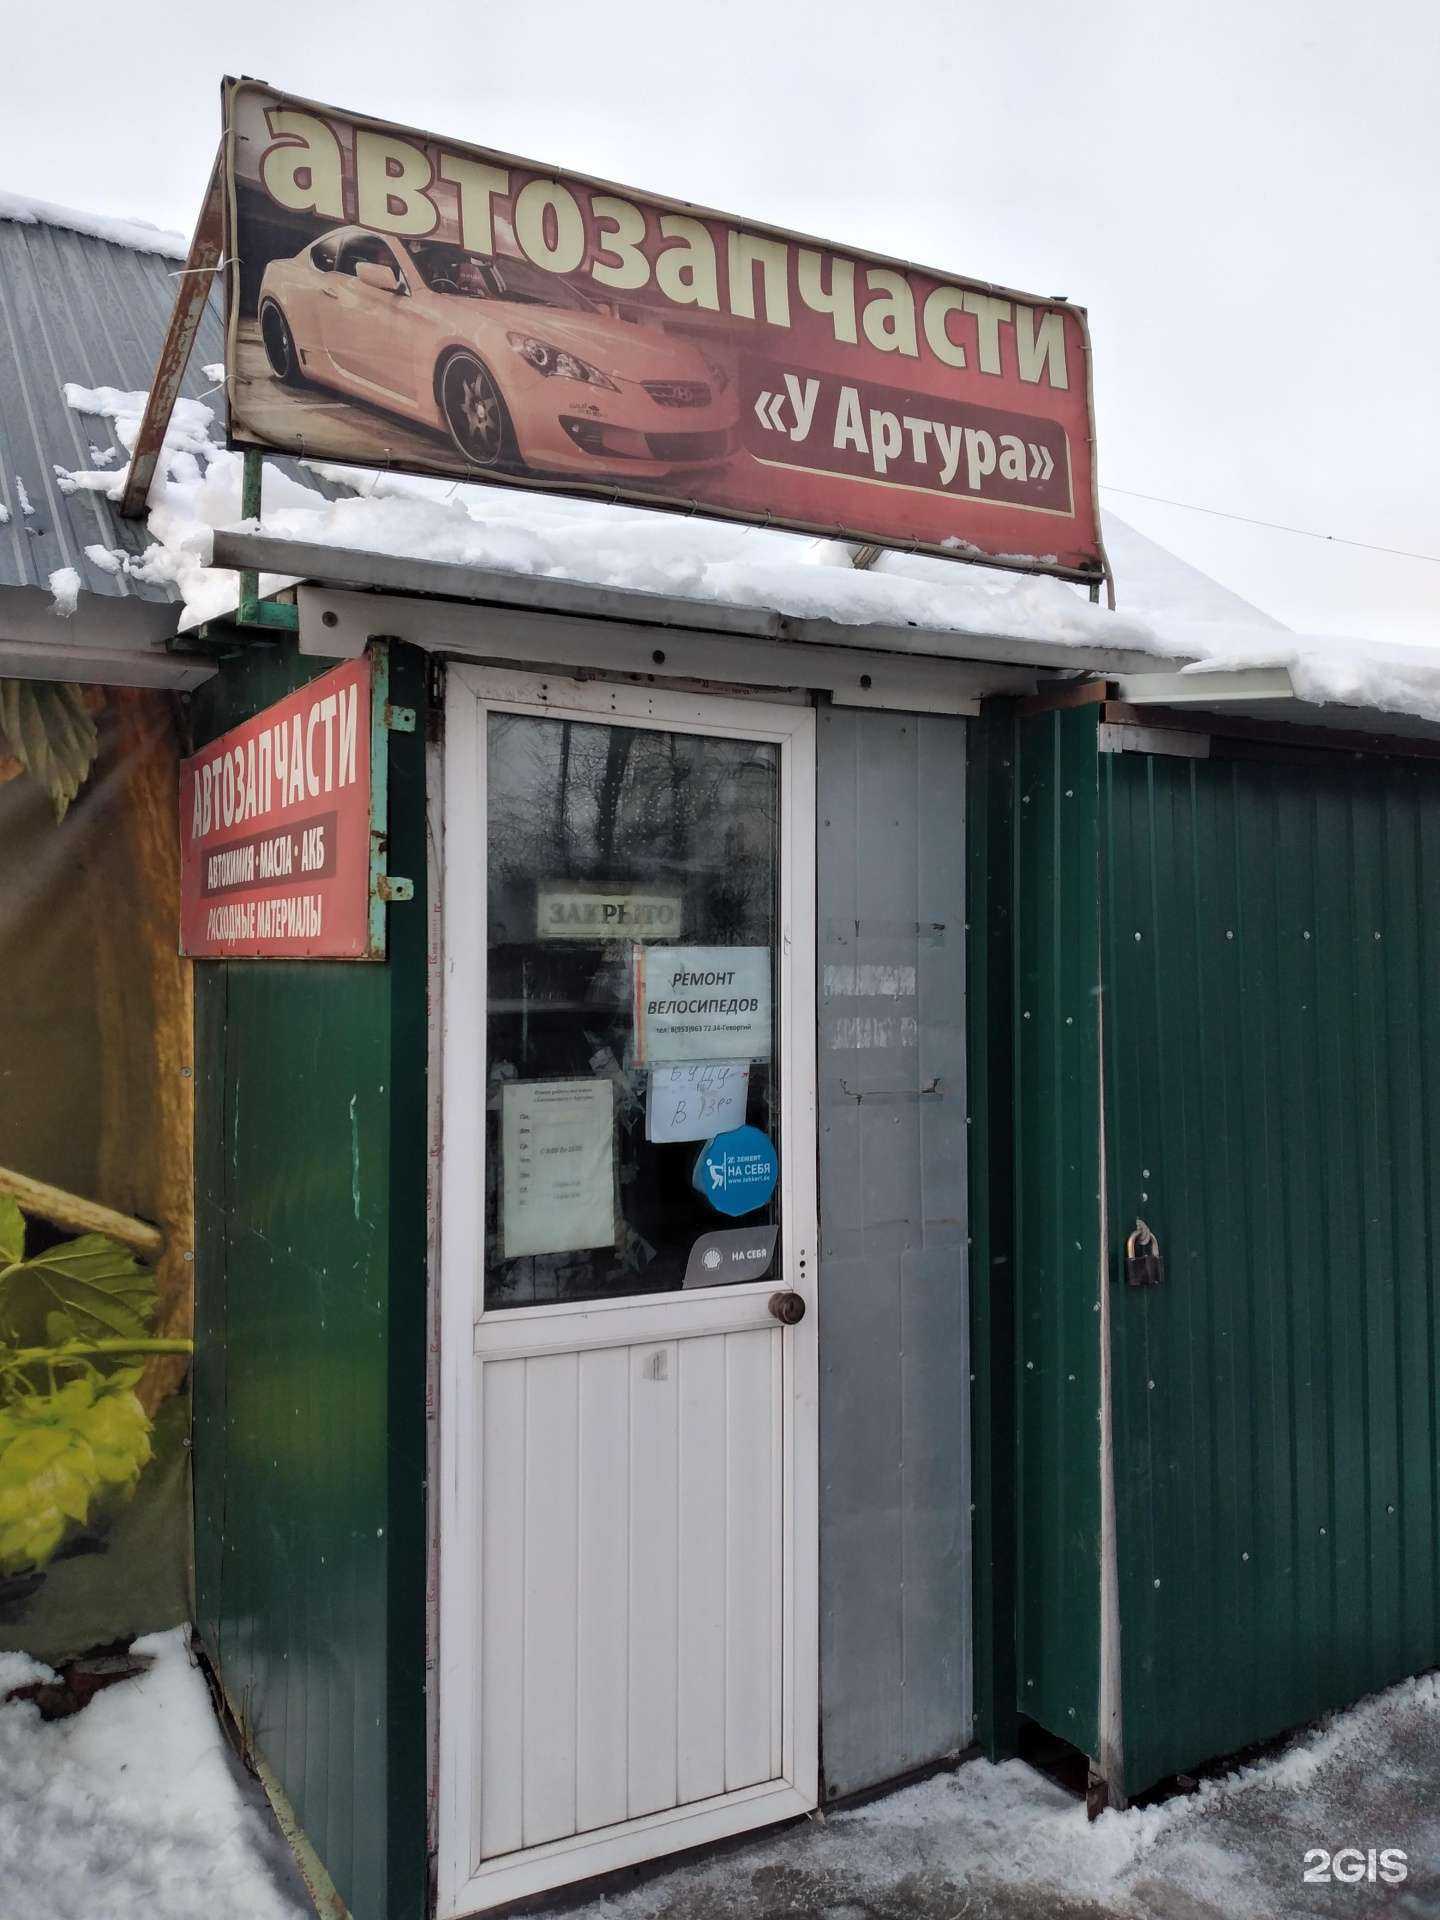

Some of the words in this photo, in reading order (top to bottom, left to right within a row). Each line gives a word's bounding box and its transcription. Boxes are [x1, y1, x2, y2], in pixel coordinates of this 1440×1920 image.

[262, 106, 1070, 391] автозапчасти
[833, 385, 1055, 490] Артура»
[192, 683, 358, 840] АВТОЗАПЧАСТИ
[207, 844, 255, 889] АВТОХИМИЯ
[259, 834, 293, 879] МАСЛА
[301, 826, 325, 872] АКБ
[207, 902, 256, 947] РАСХОДНЫЕ
[257, 894, 322, 940] МАТЕРИАЛЫ
[672, 971, 736, 987] РЕМОНТ
[648, 998, 759, 1015] ВЕЛОСИПЕДОВ
[671, 1100, 687, 1127] В
[728, 1165, 743, 1177] НА
[745, 1162, 771, 1175] СЕБЯ
[732, 1250, 745, 1261] НА
[746, 1249, 767, 1260] СЕБЯ
